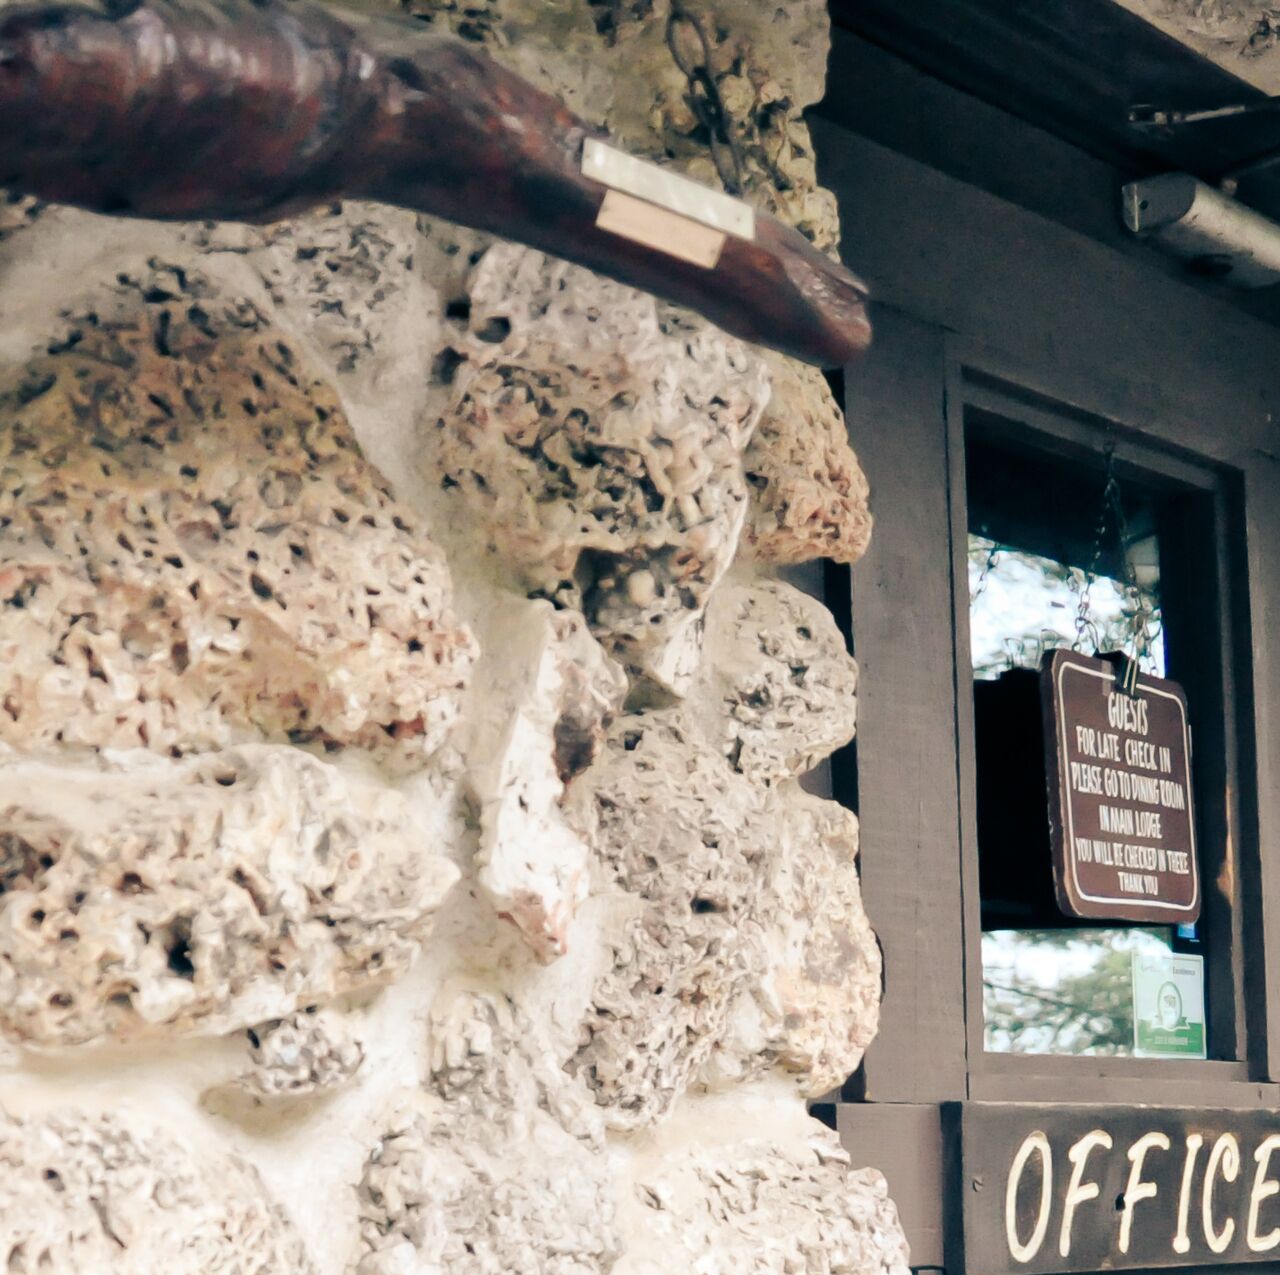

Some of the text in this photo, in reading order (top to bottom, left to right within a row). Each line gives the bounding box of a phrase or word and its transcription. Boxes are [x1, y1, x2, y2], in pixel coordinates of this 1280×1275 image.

[1109, 693, 1148, 736] GUESTS
[1077, 726, 1171, 773] FOR LATE CHECK IN
[1072, 762, 1185, 810] PLEASE GO TO DINING ROOM
[1099, 805, 1162, 839] IN MAIN LODGE
[1076, 838, 1189, 874] YOU WILL BE CHECKED IN THERE
[1118, 872, 1158, 896] THANK YOU
